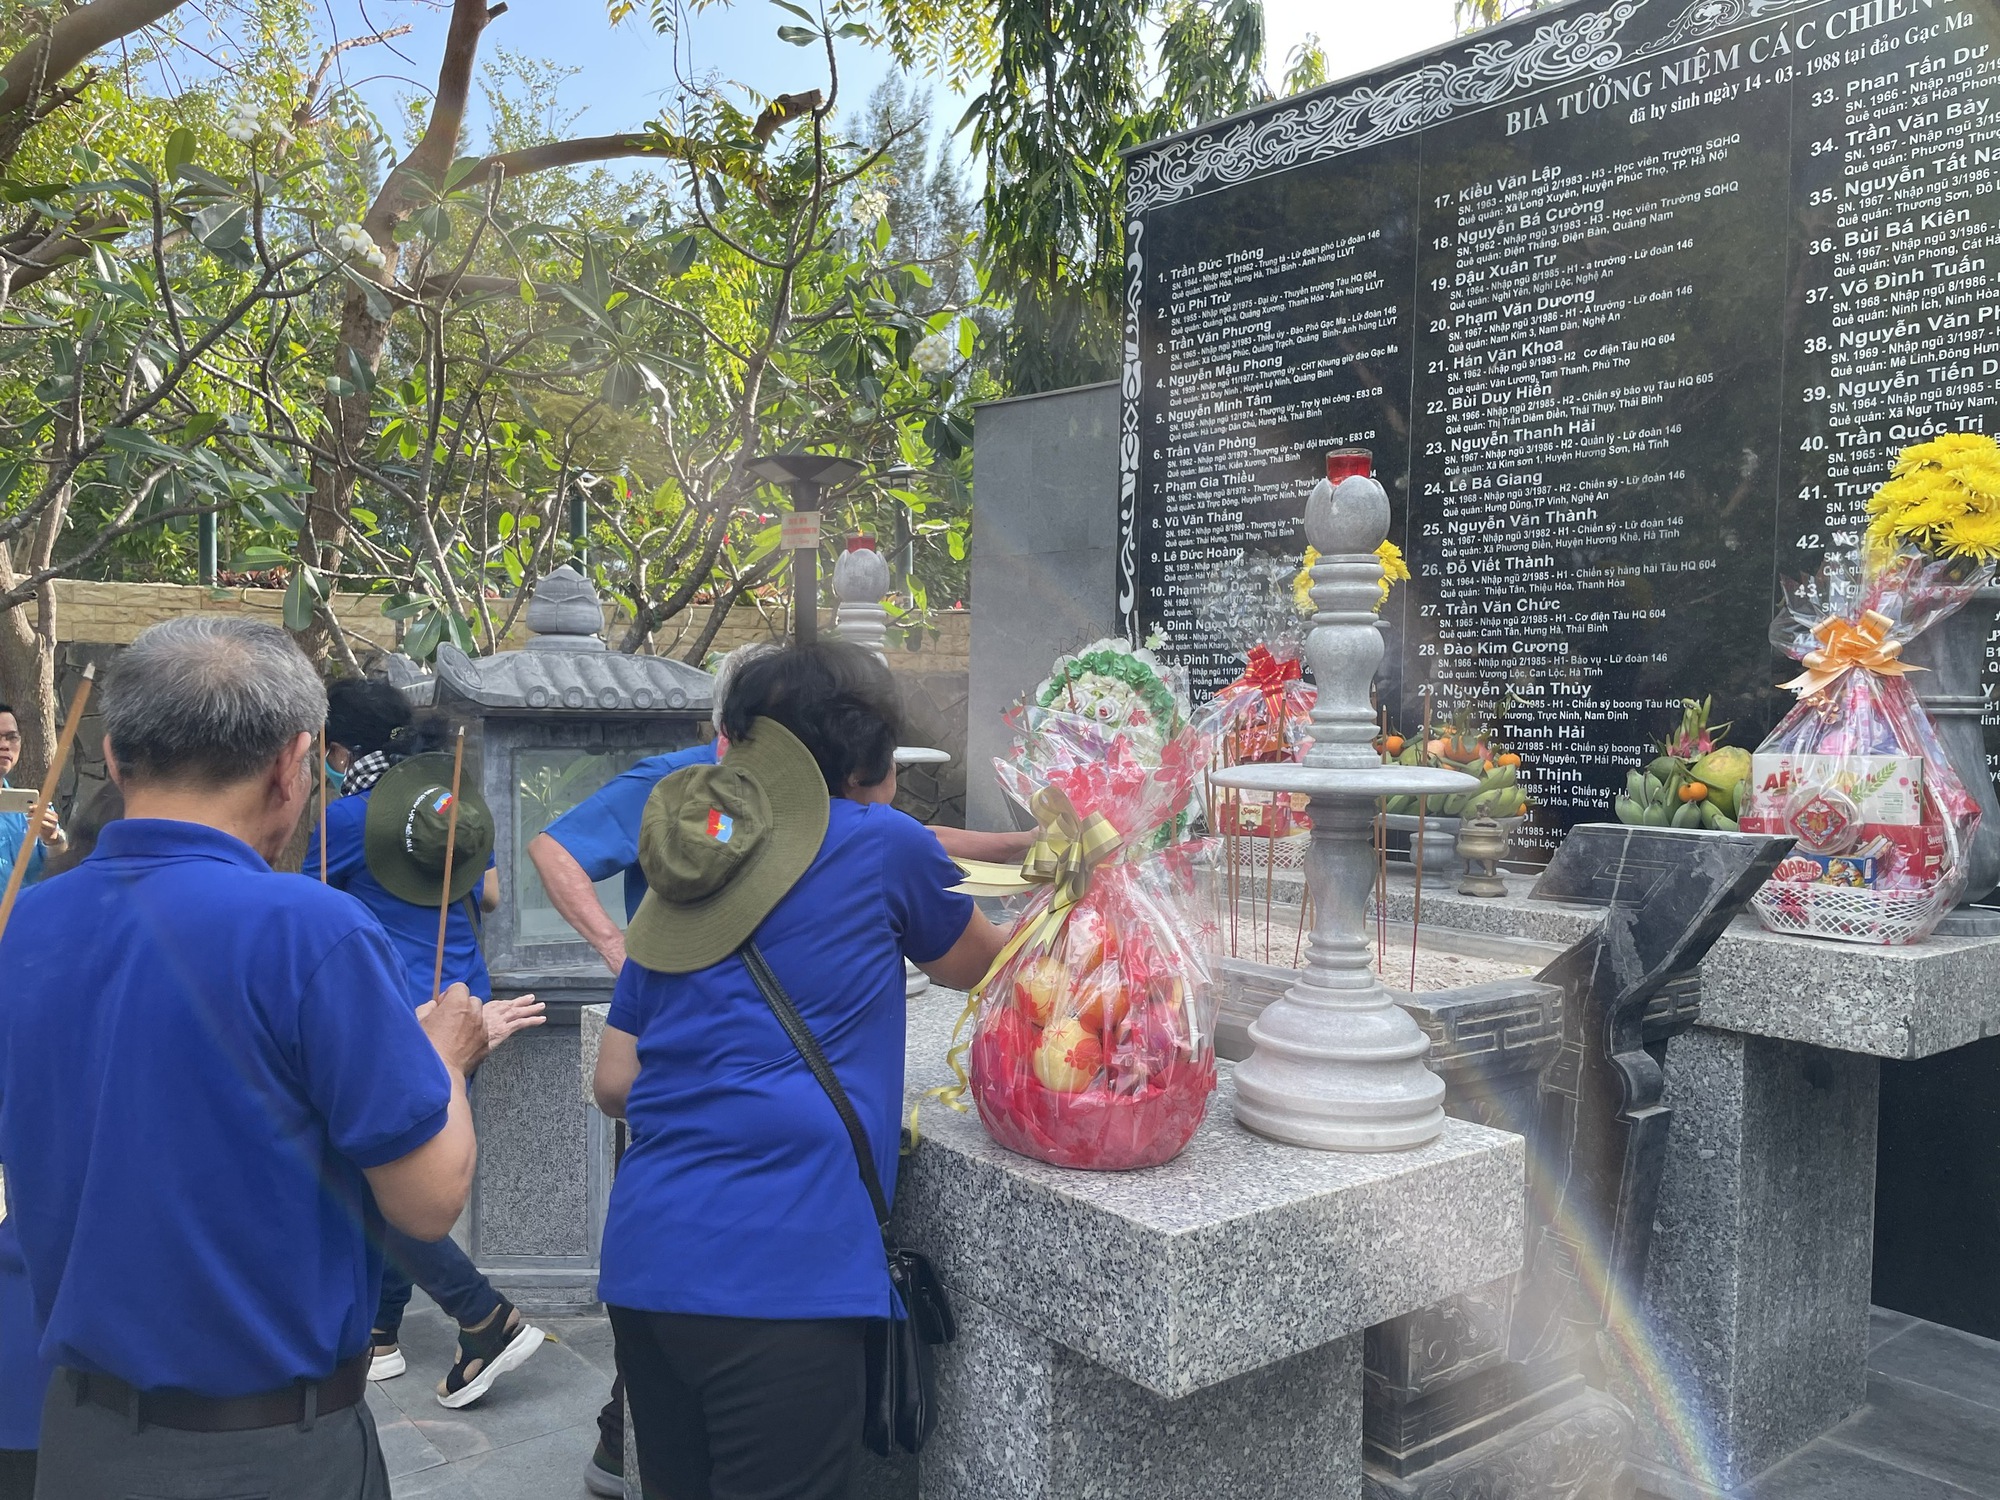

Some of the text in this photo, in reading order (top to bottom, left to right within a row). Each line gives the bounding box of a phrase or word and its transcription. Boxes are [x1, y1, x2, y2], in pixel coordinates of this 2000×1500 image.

[1505, 102, 1549, 137] BIA
[1556, 70, 1652, 120] TƯỞNG
[1660, 43, 1742, 90] NIỆM
[1749, 20, 1817, 63] CÁC
[1629, 106, 1645, 124] đã
[1650, 103, 1667, 120] hy
[1670, 91, 1700, 113] sinh
[1704, 82, 1740, 105] ngày
[1744, 73, 1761, 92] 14
[1775, 65, 1793, 84] 03
[1806, 51, 1840, 76] 1988
[1844, 42, 1865, 64] tại
[1870, 33, 1900, 56] đảo
[1904, 24, 1939, 44] Gạc
[1944, 11, 1973, 33] Ma
[1811, 44, 1989, 107] 33. Phan Tấn Dư
[1810, 97, 1990, 156] 34. Trần Văn Bảy
[1434, 165, 1561, 208] 17. Kiều Văn Lập
[1809, 187, 1837, 206] 35.
[1845, 164, 1924, 197] Nguyễn
[1932, 152, 1967, 174] Tất
[1432, 199, 1604, 250] 18. Nguyễn Bá Cường
[1808, 208, 1969, 255] 36. Bùi Bá Kiên
[1158, 247, 1263, 283] 1. Trần Đức Thông
[1430, 254, 1556, 291] 19. Đậu Xuân Tư
[1805, 254, 1984, 304] 37. Võ Đình Tuấn
[1157, 291, 1230, 319] 2. Vũ Phi Trừ
[1156, 321, 1271, 354] 3. Trần Văn Phương
[1804, 336, 1832, 354] 38.
[1840, 318, 1920, 348] Nguyễn
[1927, 312, 1969, 331] Văn
[1156, 355, 1282, 388] 4. Nguyễn Mậu Phong
[1428, 340, 1563, 374] 21. Hán Văn Khoa
[1426, 386, 1551, 414] 22. Bùi Duy Hiền
[1802, 386, 1831, 402] 39.
[1838, 370, 1919, 398] Nguyễn
[1927, 361, 1974, 383] Tiến
[1425, 418, 1595, 456] 23. Nguyễn Thanh Hải
[1800, 414, 1983, 452] 40. Trần Quốc Trị
[1423, 472, 1542, 495] 24. Lê Bá Giang
[1422, 507, 1598, 536] 25. Nguyễn Văn Thành
[1420, 597, 1560, 616] 27. Trần Văn Chức
[1418, 640, 1568, 656] 28. Đào Kim Cương
